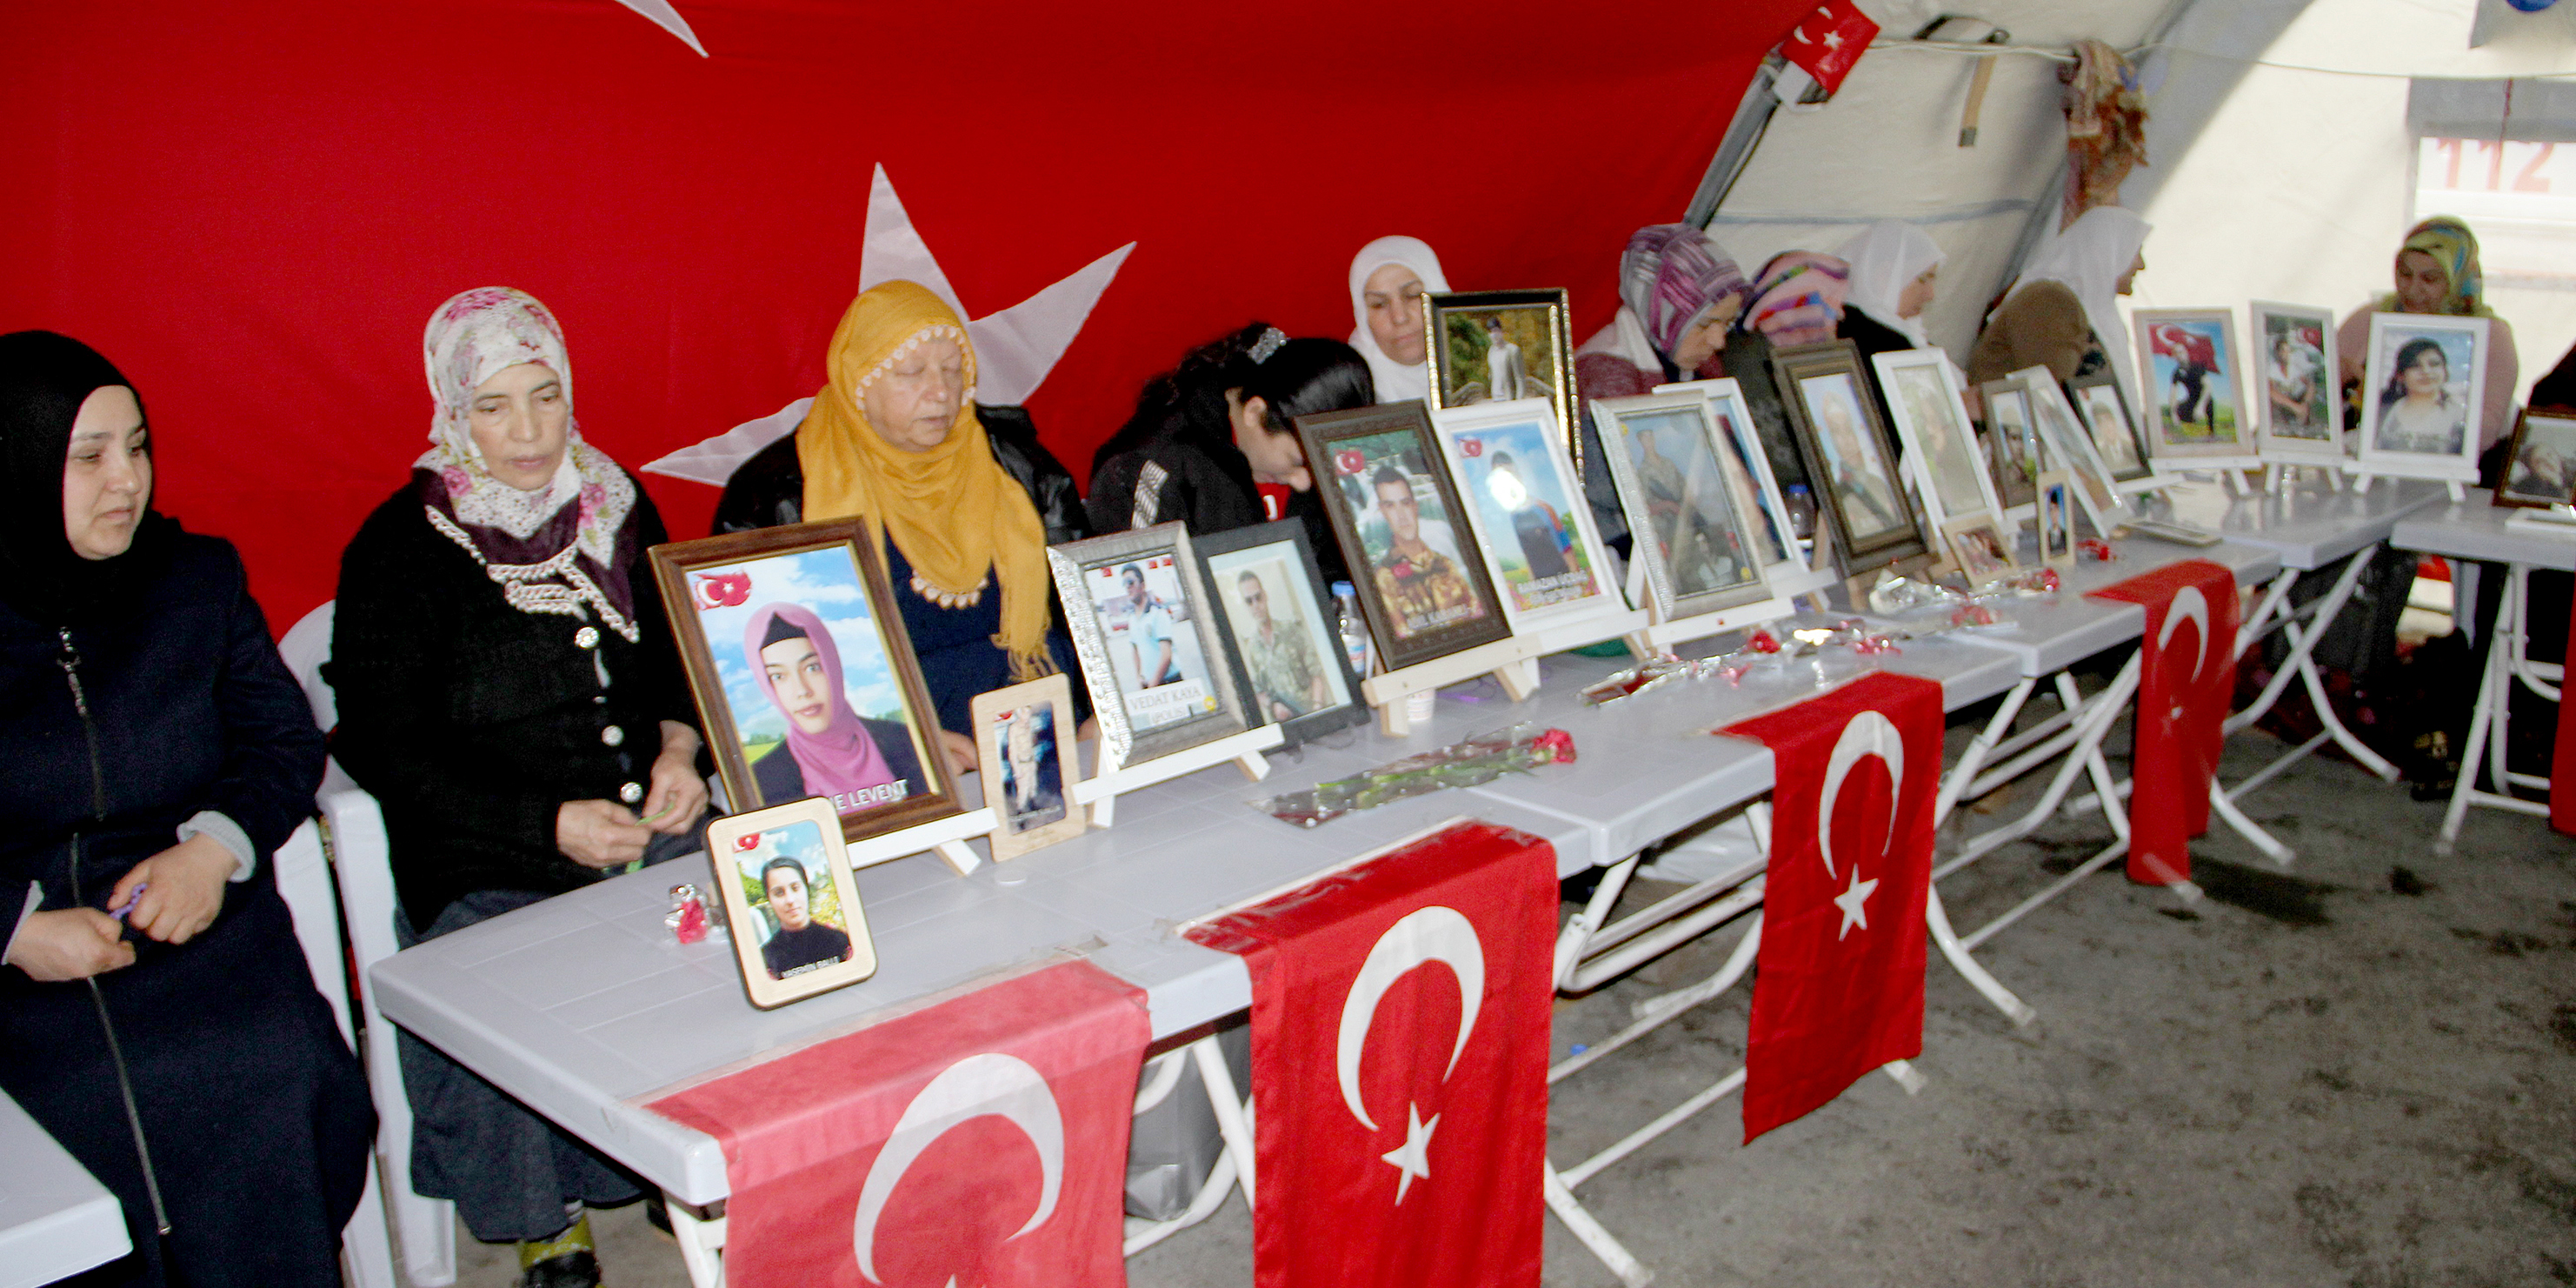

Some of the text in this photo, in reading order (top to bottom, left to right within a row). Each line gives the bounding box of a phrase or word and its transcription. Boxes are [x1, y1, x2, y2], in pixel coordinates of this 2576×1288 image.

[2437, 138, 2553, 192] 112
[1130, 685, 1201, 710] VEDAT KAYA
[848, 778, 908, 807] LEVENT
